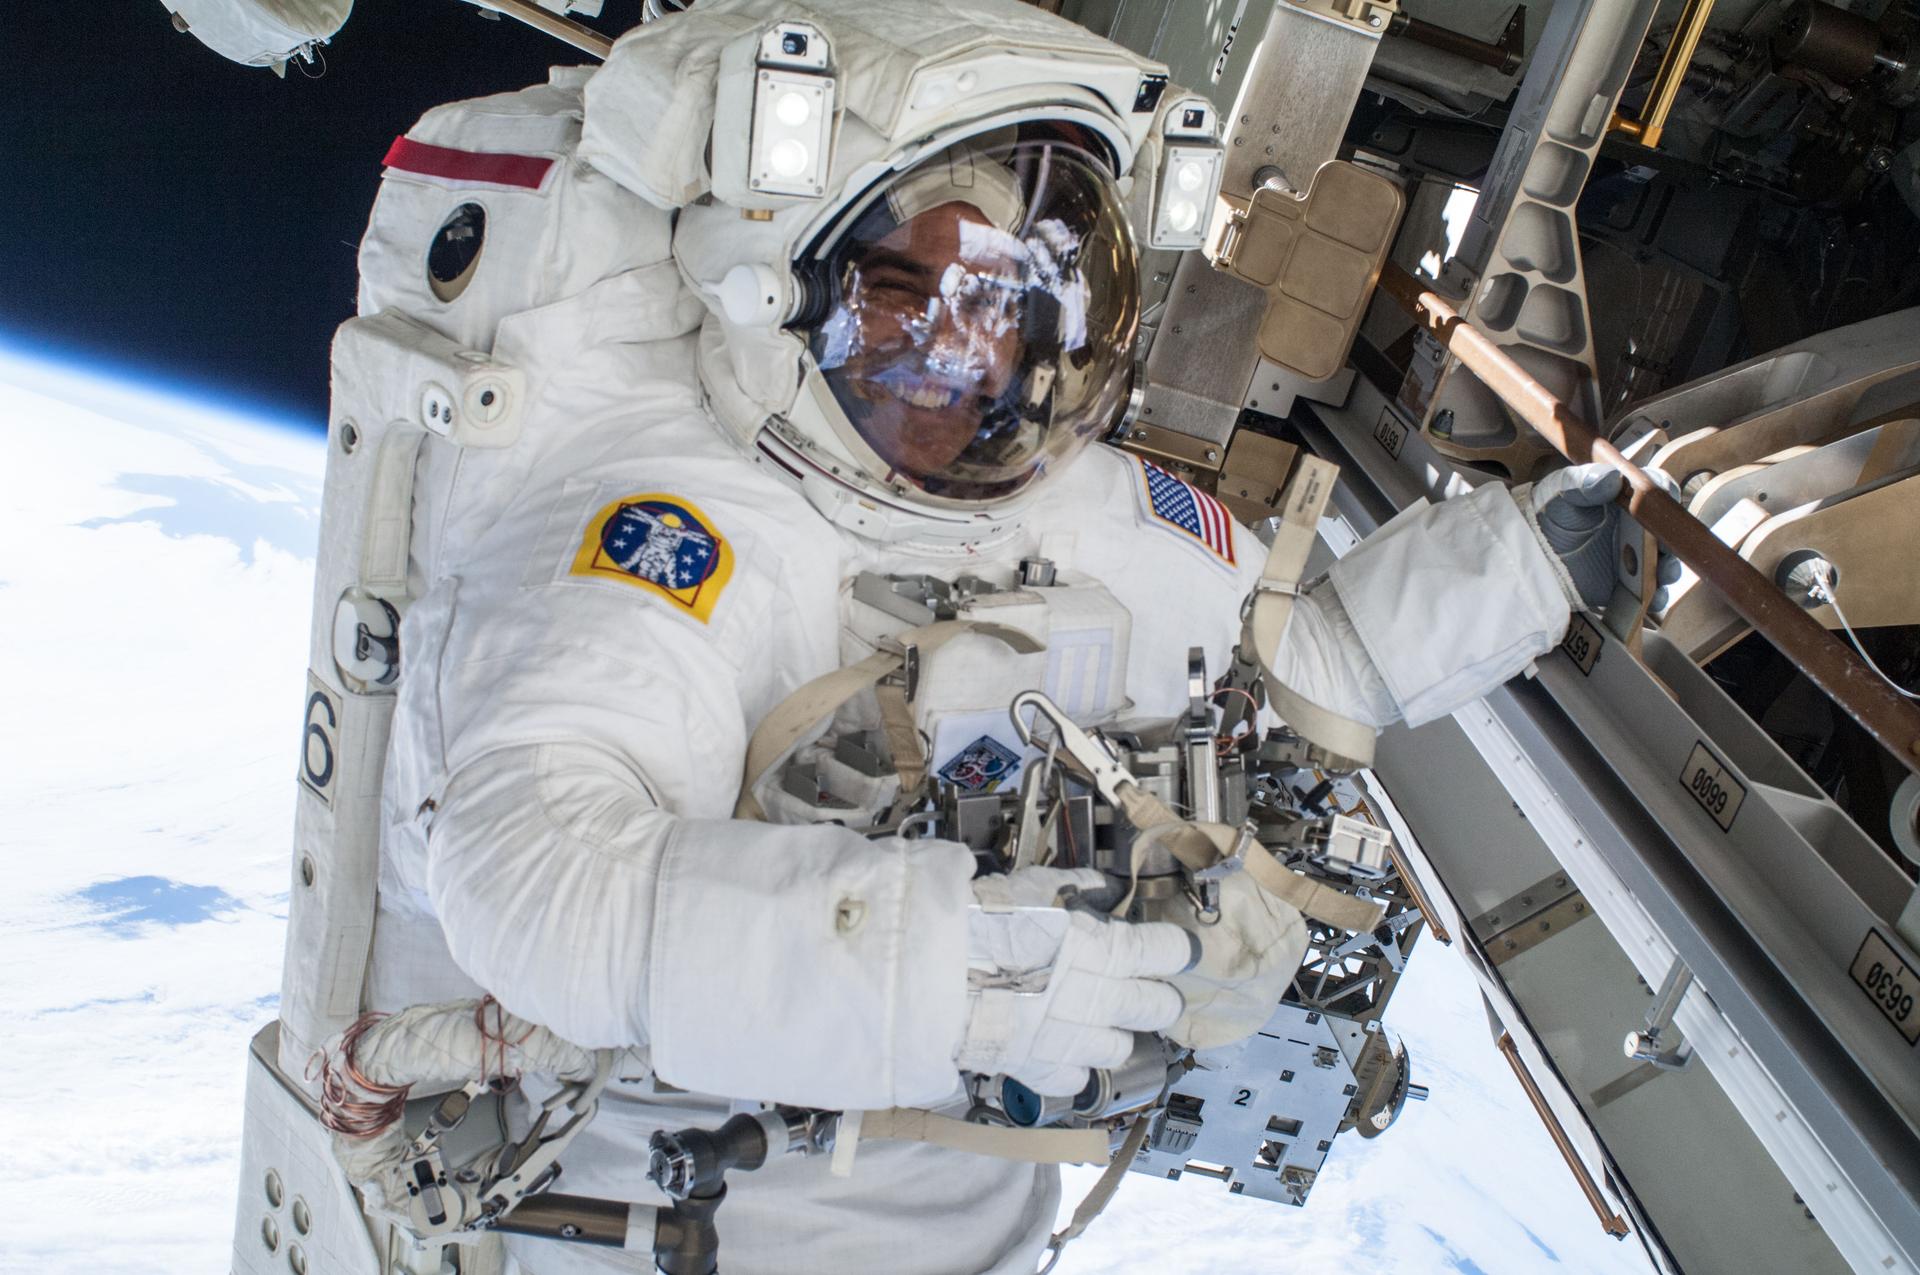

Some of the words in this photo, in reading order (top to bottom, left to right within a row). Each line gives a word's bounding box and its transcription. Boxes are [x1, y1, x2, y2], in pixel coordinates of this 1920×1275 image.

[1216, 17, 1241, 75] PNL
[304, 691, 336, 787] 6
[1692, 768, 1728, 814] 6600
[1866, 962, 1913, 1022] 6630
[1234, 1089, 1252, 1107] 2
